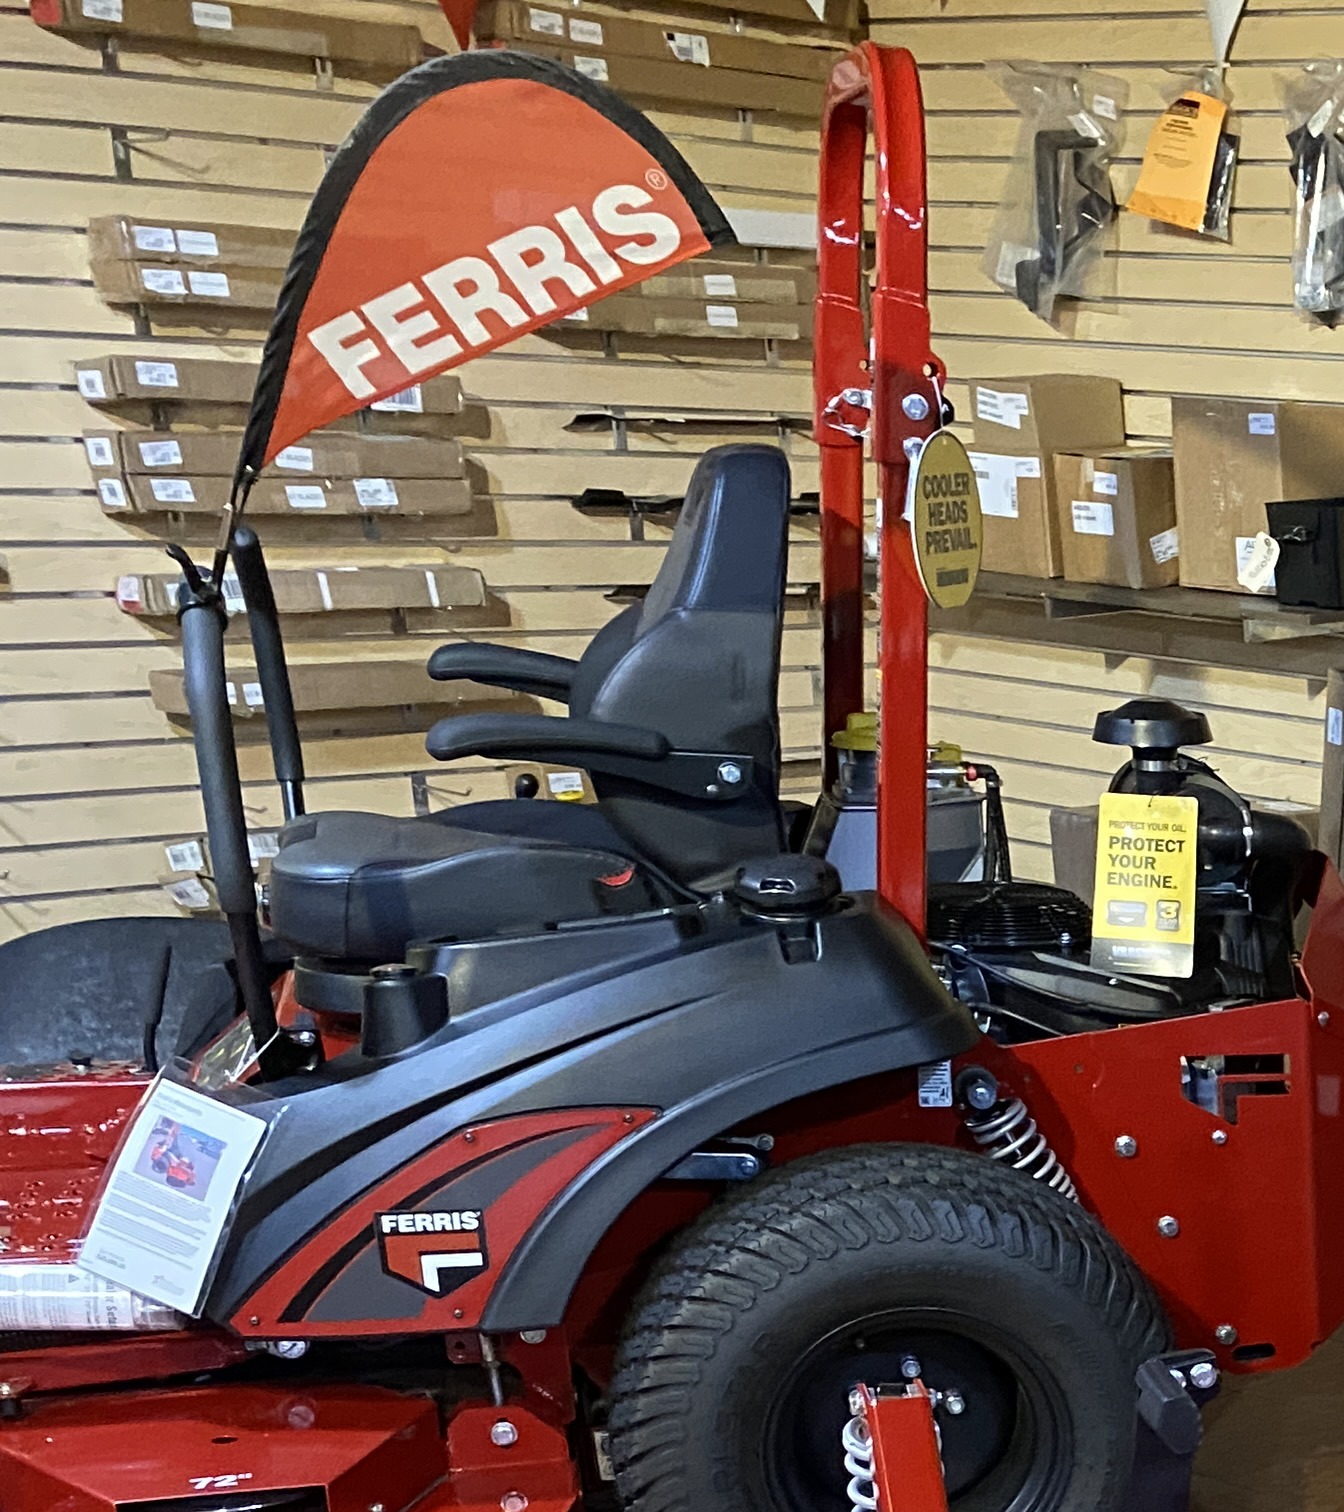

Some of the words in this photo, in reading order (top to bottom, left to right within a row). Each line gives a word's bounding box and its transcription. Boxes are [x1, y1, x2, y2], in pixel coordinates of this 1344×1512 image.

[307, 184, 681, 400] FERRIS
[922, 473, 970, 499] COOLER
[928, 501, 968, 527] HEADS
[926, 527, 977, 555] PREVAIL.
[1109, 820, 1145, 830] PROTECT
[1146, 822, 1169, 832] YOUR
[1172, 823, 1187, 833] OIL.
[1108, 836, 1186, 853] PROTECT
[1108, 854, 1156, 870] YOUR
[1107, 872, 1178, 890] ENGINE.
[381, 1211, 479, 1233] FERRIS
[189, 1473, 252, 1490] 72"
